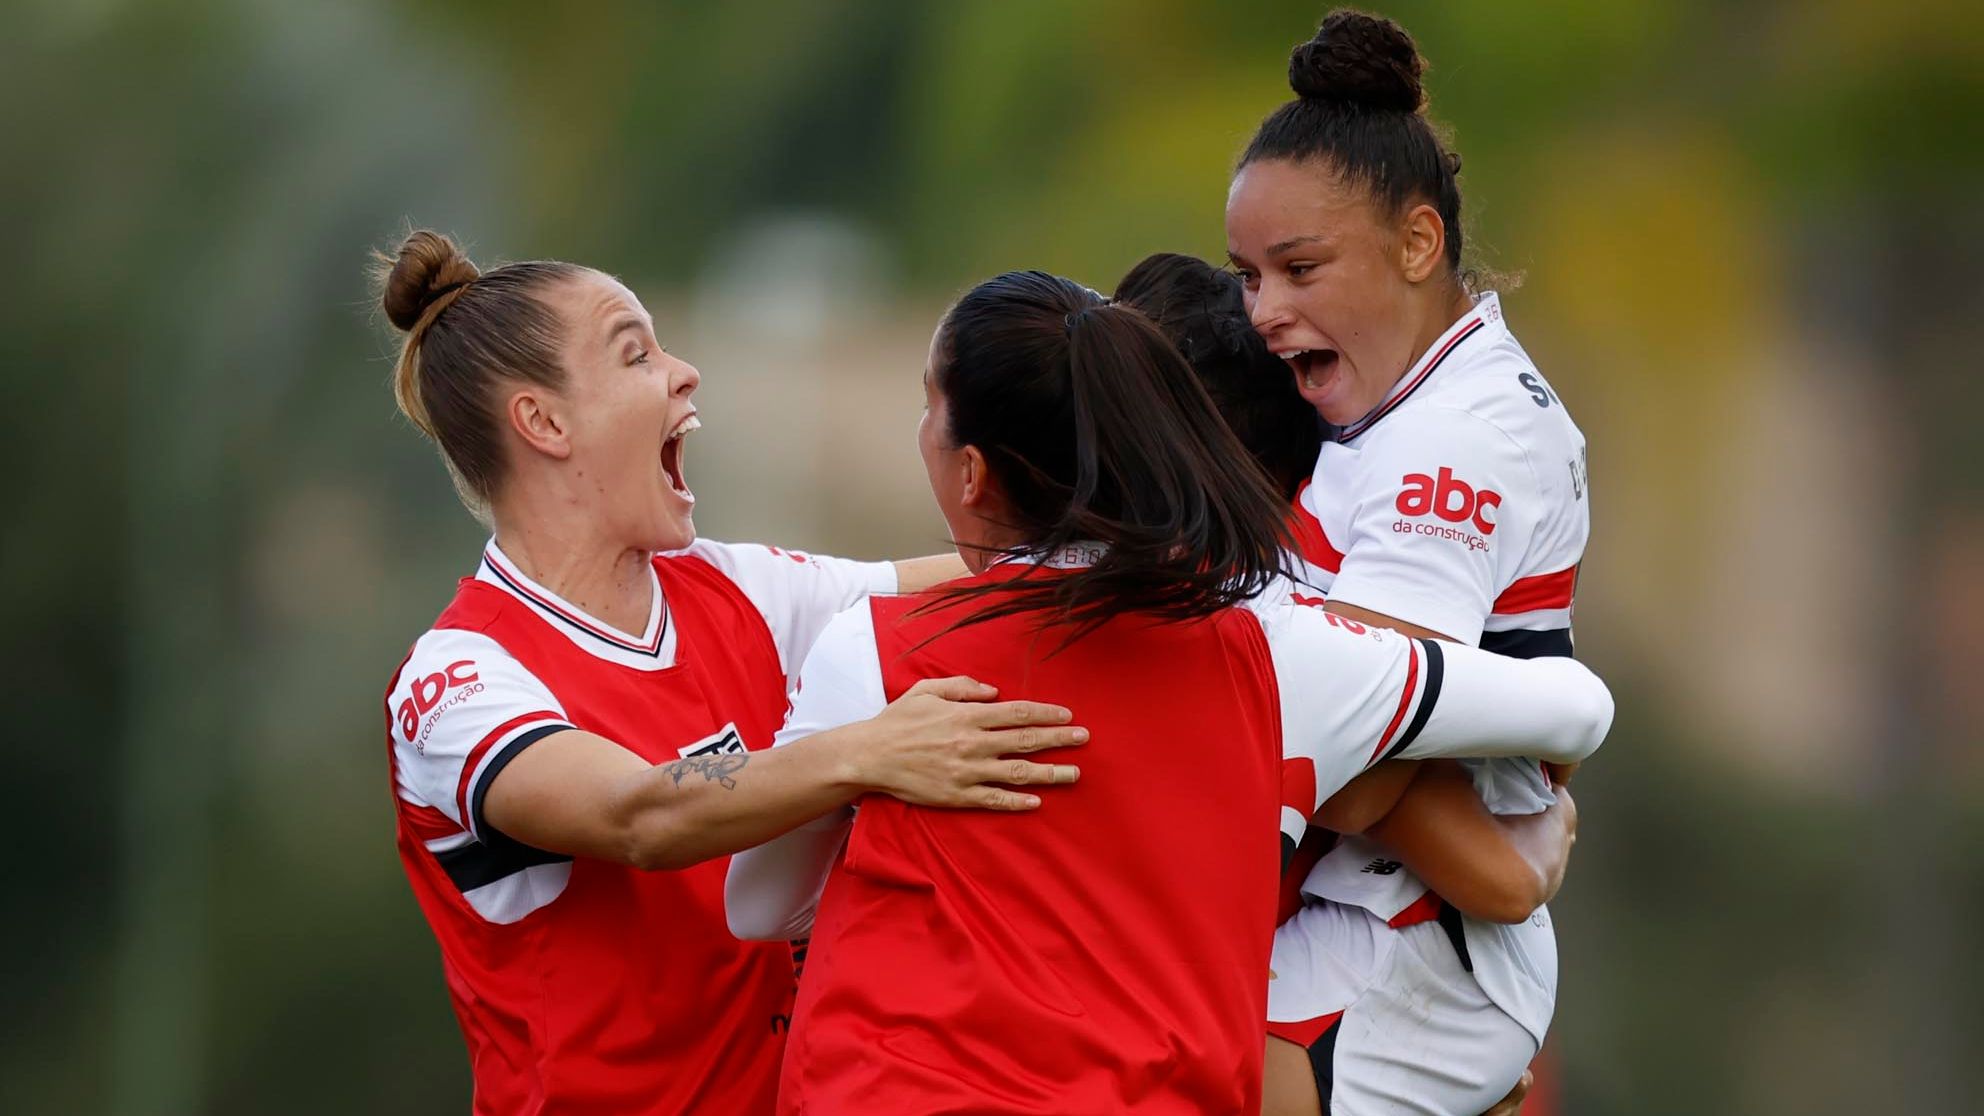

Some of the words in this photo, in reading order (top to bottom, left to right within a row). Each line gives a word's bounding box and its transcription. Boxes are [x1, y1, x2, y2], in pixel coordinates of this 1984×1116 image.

[1518, 372, 1559, 409] S
[1395, 466, 1502, 536] abc
[1392, 518, 1412, 534] da
[1415, 522, 1490, 552] construção
[397, 659, 479, 743] abc
[420, 682, 485, 742] construção
